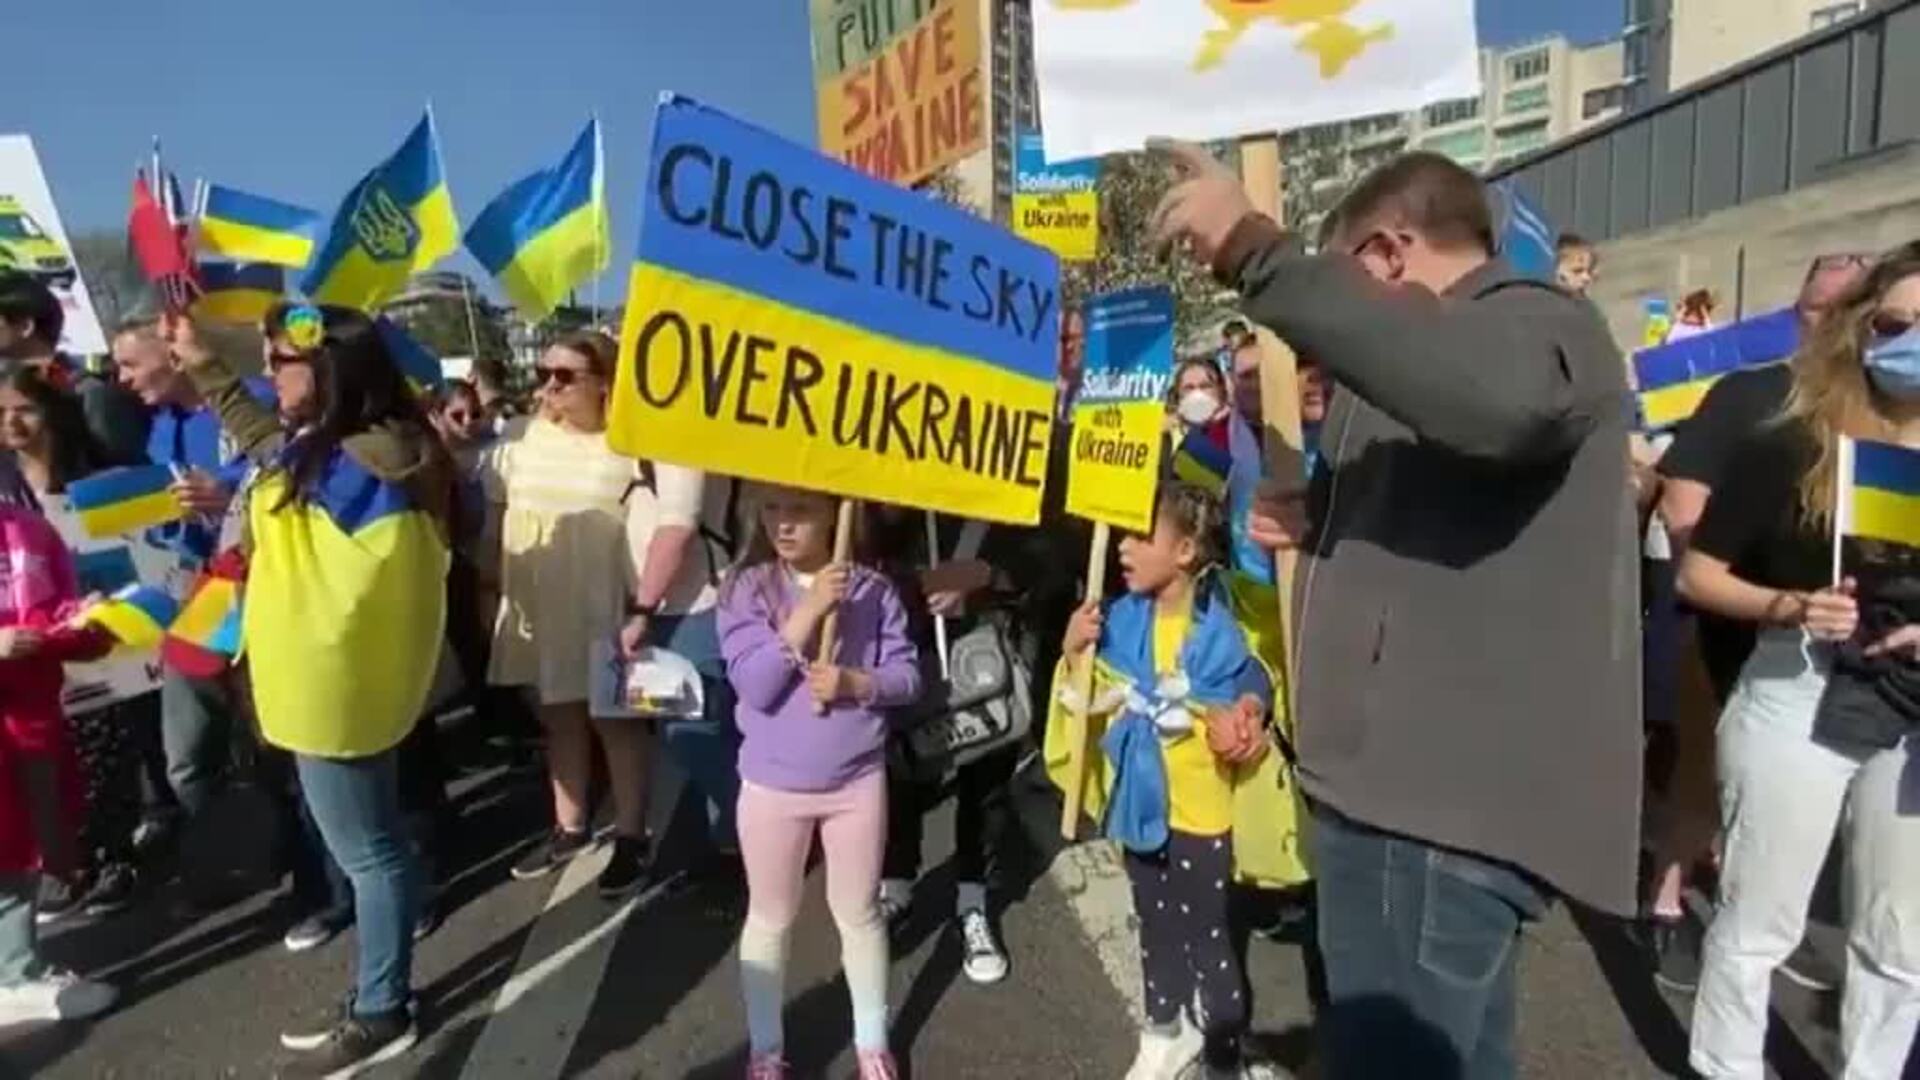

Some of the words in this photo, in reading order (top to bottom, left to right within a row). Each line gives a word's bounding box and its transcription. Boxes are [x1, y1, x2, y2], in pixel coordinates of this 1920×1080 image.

[843, 8, 953, 137] SAVE
[846, 67, 980, 181] KRAINE
[1018, 171, 1096, 194] Solidarity
[1023, 209, 1090, 229] Ukraine
[657, 143, 858, 280] CLOSE
[868, 211, 954, 311] THE
[962, 254, 1054, 343] SKY
[634, 310, 825, 437] OVER
[832, 362, 1051, 488] UKRAINE
[1080, 365, 1167, 402] Solidarity
[1076, 430, 1149, 468] Ukraine
